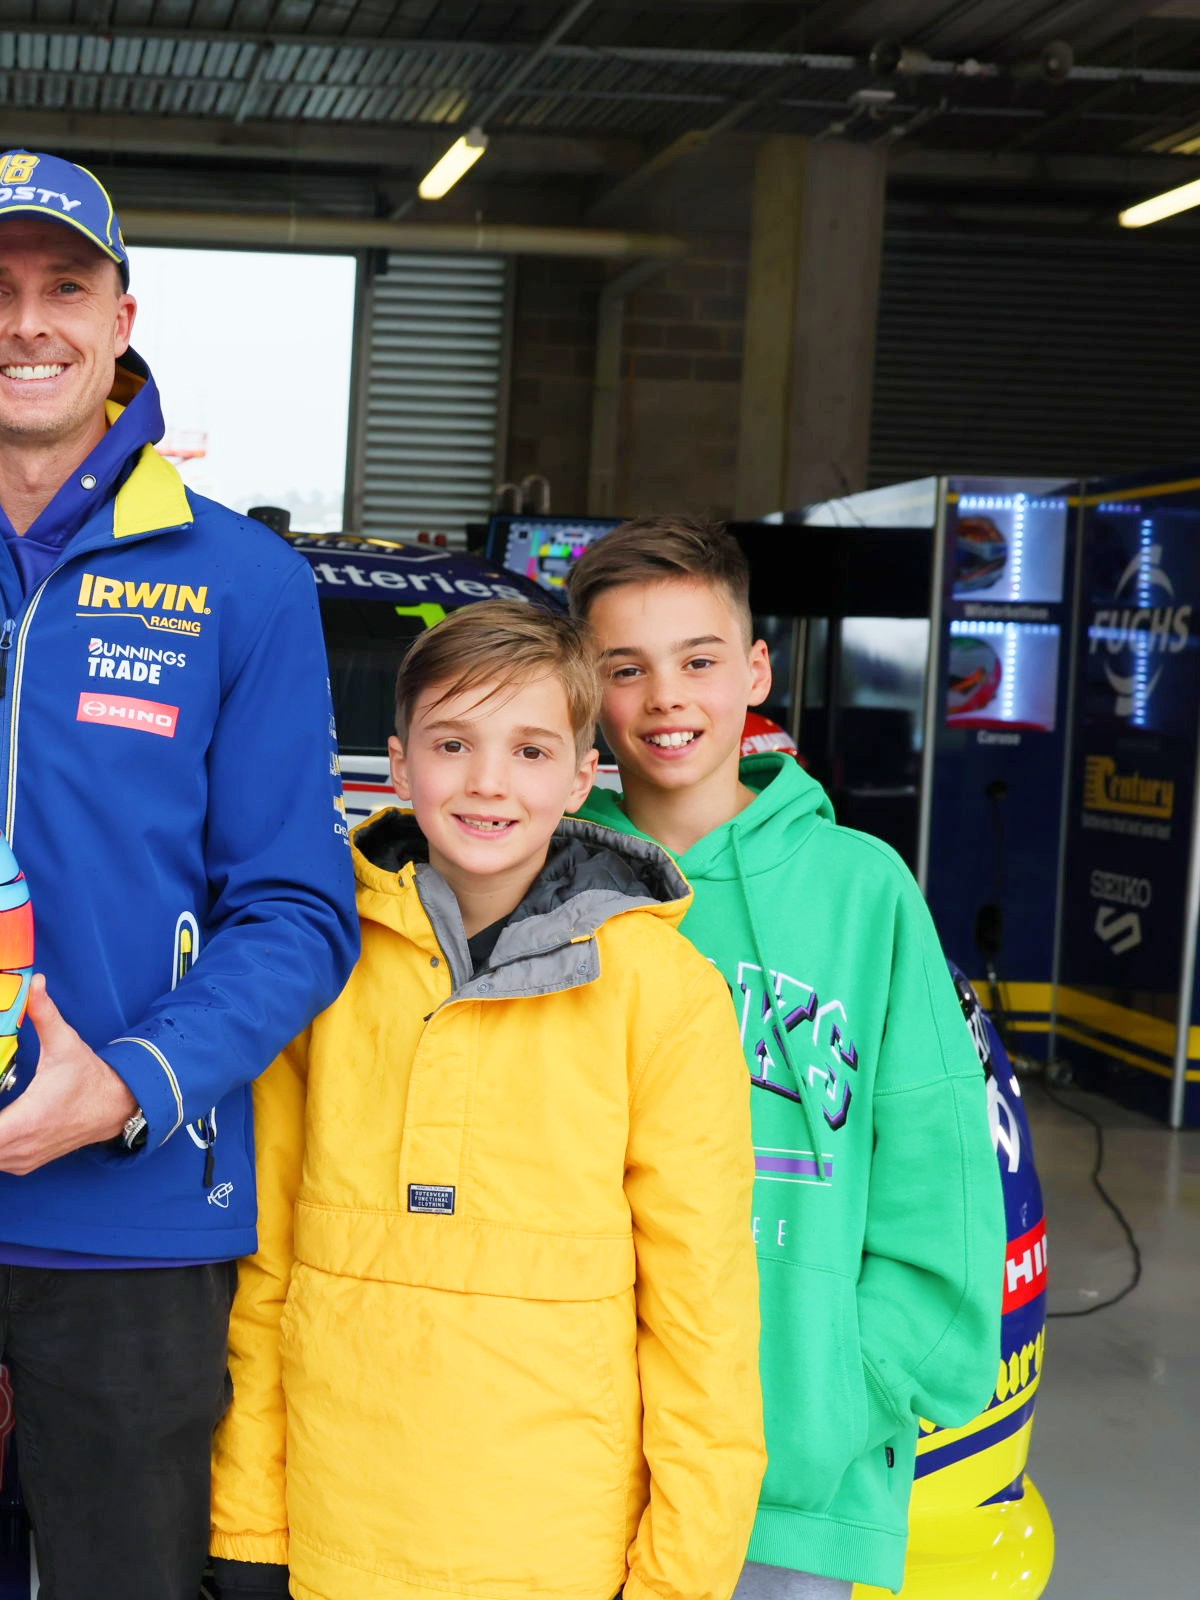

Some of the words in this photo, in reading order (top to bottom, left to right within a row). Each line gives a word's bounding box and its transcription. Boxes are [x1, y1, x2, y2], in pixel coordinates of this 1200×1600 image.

[78, 573, 208, 614] IRWIN
[313, 563, 529, 603] tteries
[150, 615, 201, 633] RACING
[1089, 606, 1191, 654] FUCHS
[88, 638, 186, 667] BUNNINGS
[88, 657, 162, 685] TRADE
[108, 706, 172, 727] HINO
[1090, 869, 1151, 908] SEIKO
